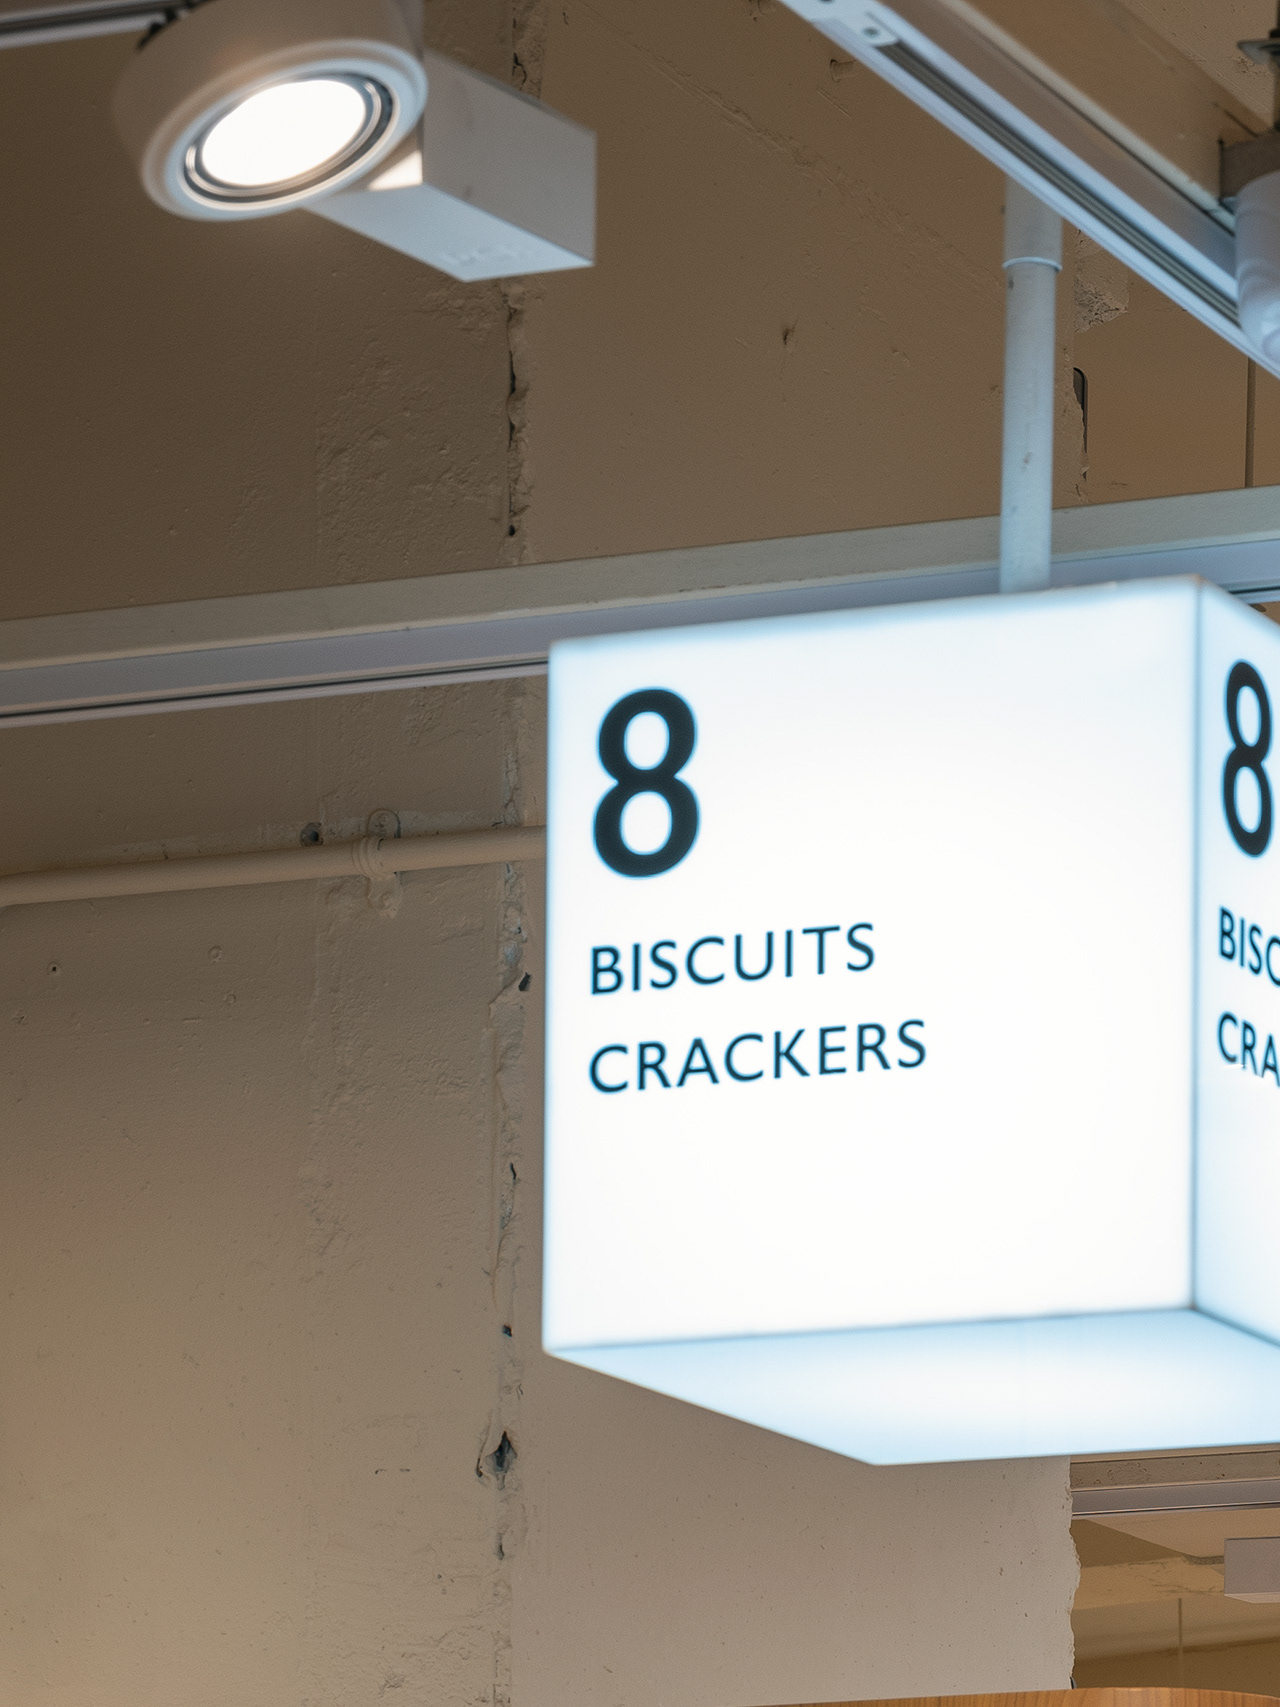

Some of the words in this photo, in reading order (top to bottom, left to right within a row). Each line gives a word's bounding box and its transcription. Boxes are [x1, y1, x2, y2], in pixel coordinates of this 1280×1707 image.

[592, 688, 700, 878] 8
[1222, 660, 1273, 859] 8
[591, 923, 876, 995] BISCUITS
[588, 1019, 927, 1094] CRACKERS
